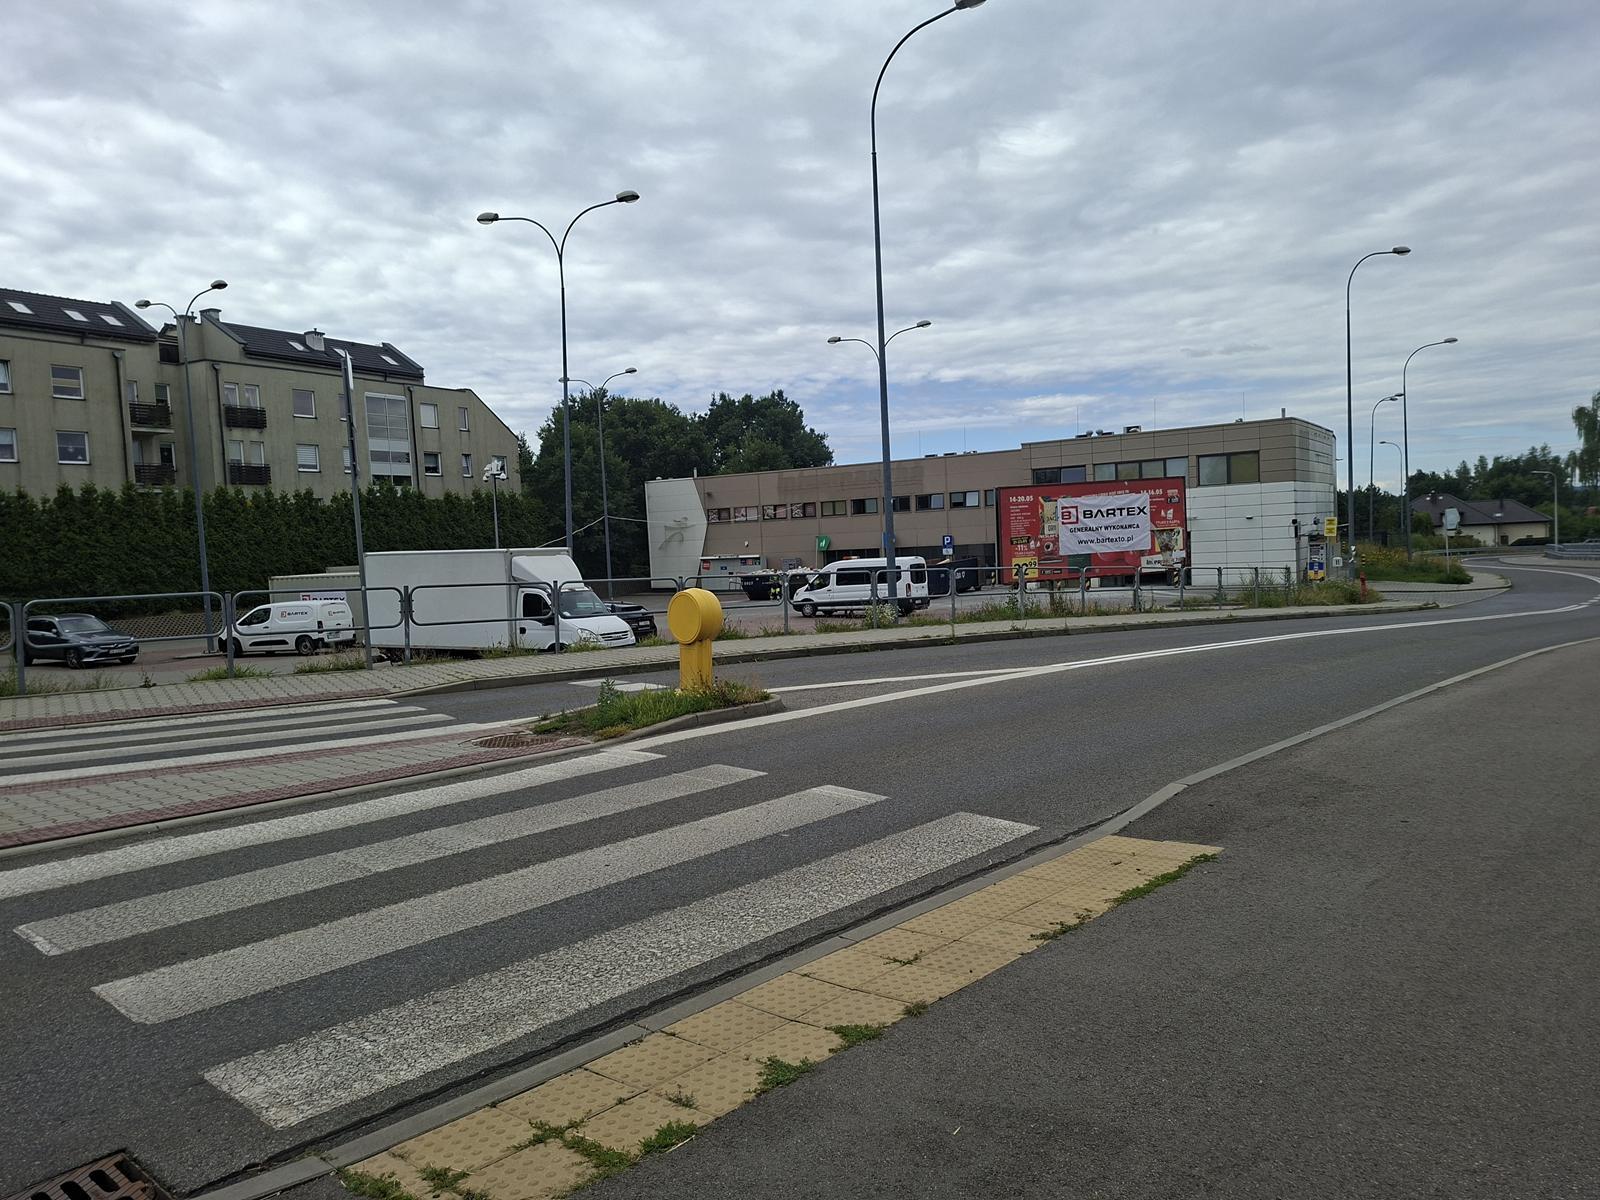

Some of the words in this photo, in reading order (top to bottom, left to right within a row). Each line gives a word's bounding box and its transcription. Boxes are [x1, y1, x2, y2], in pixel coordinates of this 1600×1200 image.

[1083, 505, 1148, 519] BARTEX
[1069, 525, 1102, 533] GENERALNY
[1103, 523, 1140, 531] WYKONAWCA
[944, 536, 951, 545] P
[1077, 534, 1134, 545] www.bartexto.pl
